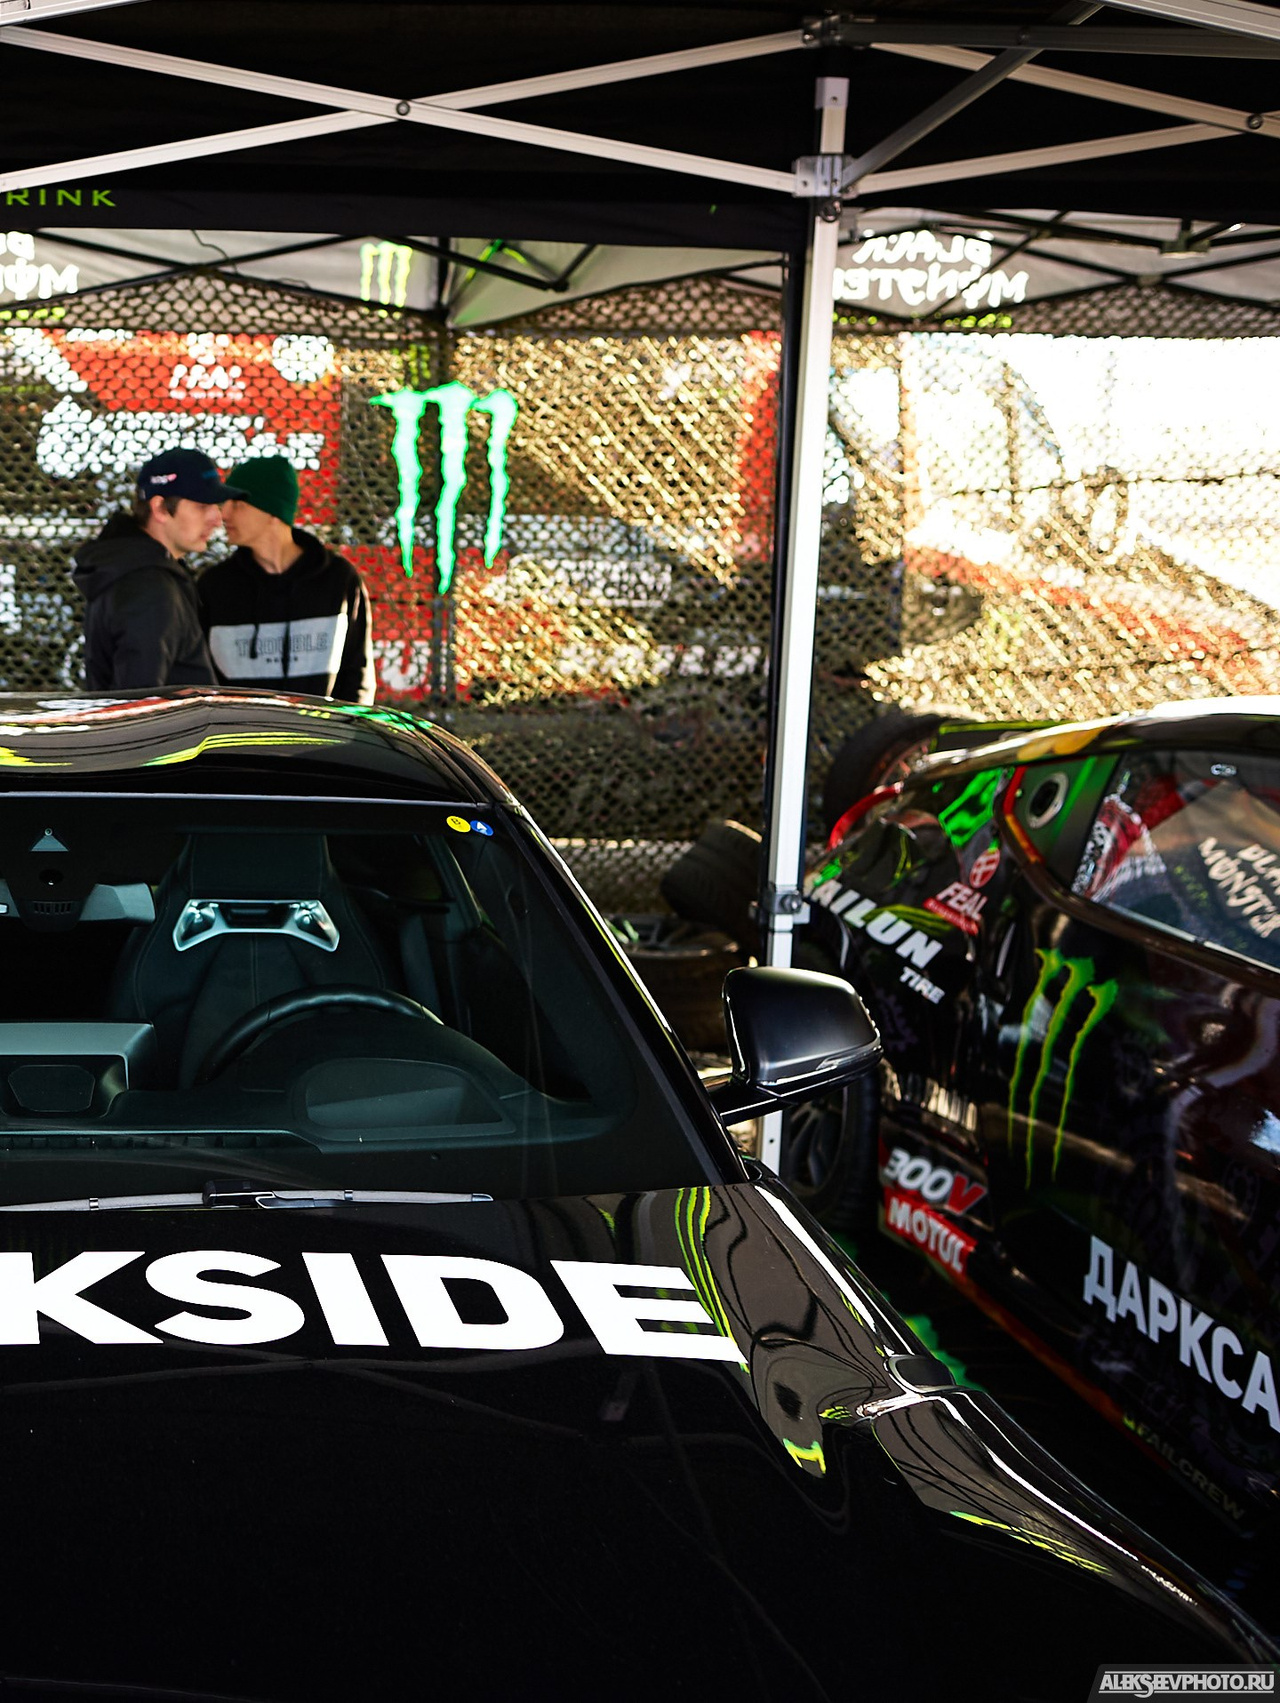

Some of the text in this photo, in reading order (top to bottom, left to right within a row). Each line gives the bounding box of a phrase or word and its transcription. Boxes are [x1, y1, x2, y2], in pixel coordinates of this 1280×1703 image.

[802, 872, 943, 969] AILUN
[936, 881, 988, 921] FEAL
[899, 966, 945, 1005] TIRE
[883, 1147, 988, 1217] 300V
[888, 1196, 967, 1274] MOTUL
